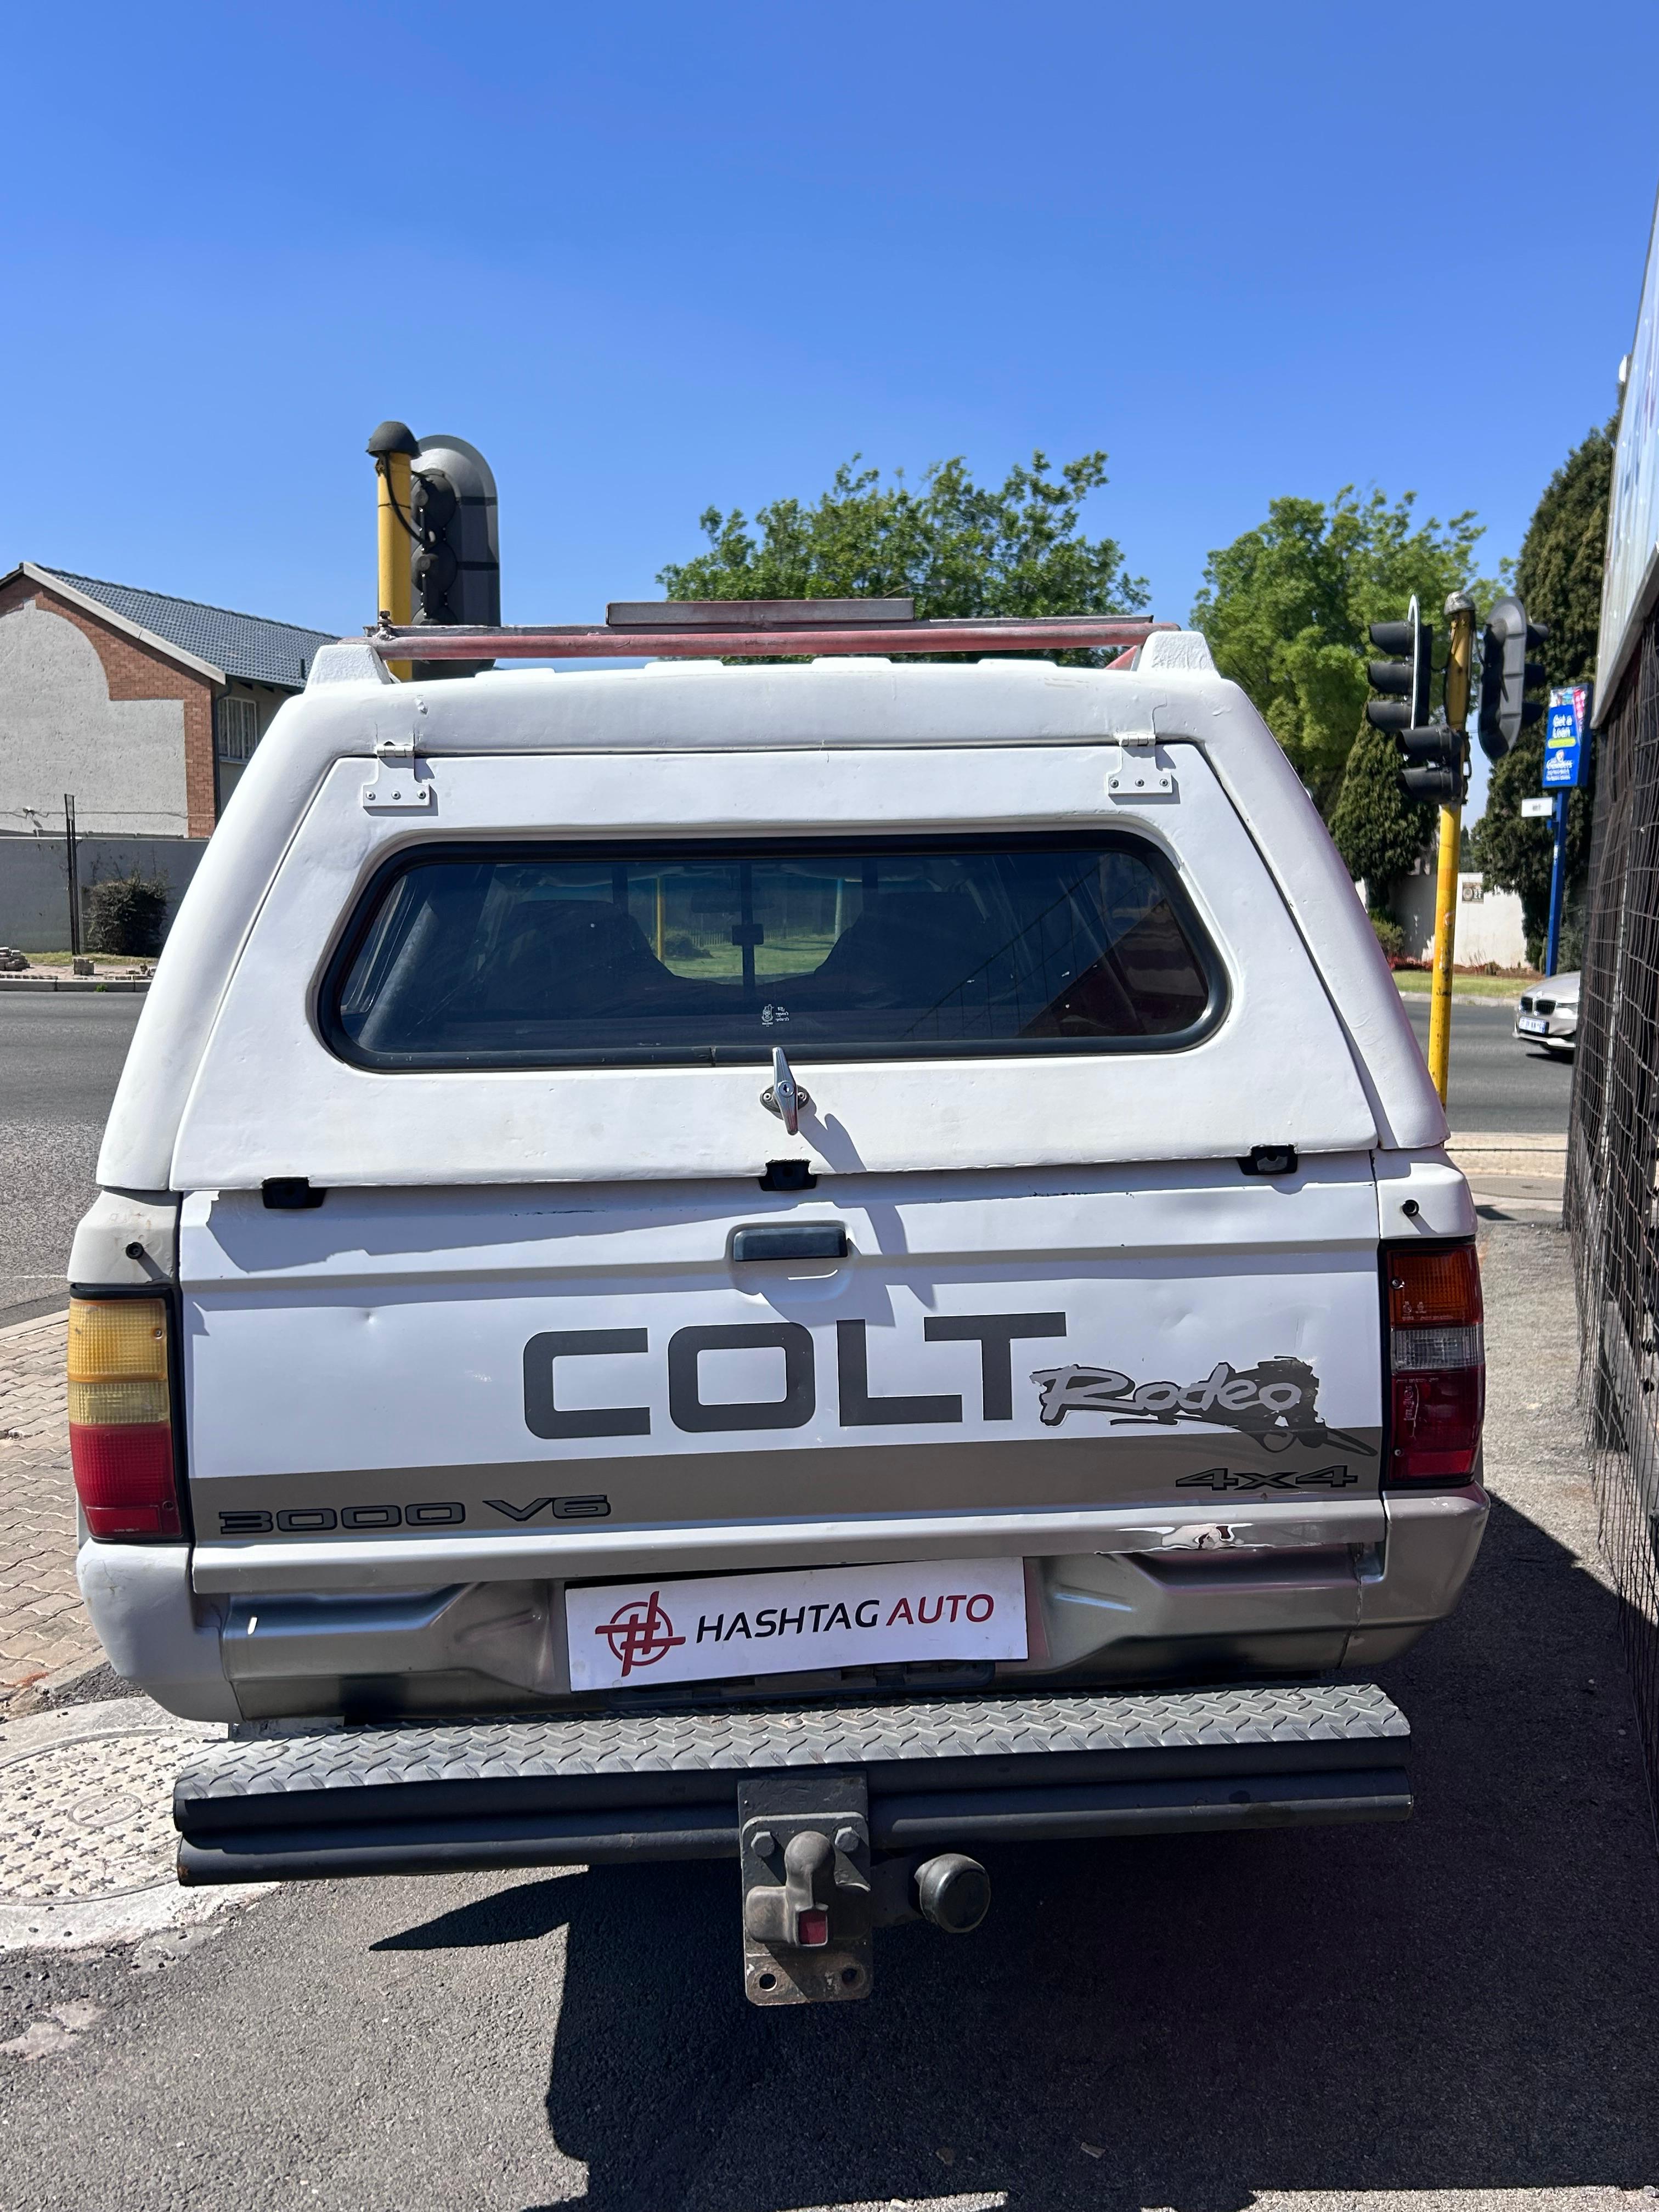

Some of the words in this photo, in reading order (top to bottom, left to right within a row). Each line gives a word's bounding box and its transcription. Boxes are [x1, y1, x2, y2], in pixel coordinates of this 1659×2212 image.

[523, 1312, 1066, 1440] COLT
[1029, 1362, 1305, 1426] Rodeo
[1176, 1465, 1358, 1491] 4x4
[219, 1502, 465, 1534] 3000
[483, 1494, 611, 1522] V6
[696, 1599, 880, 1644] HASHTAG
[886, 1593, 995, 1626] AUTO
